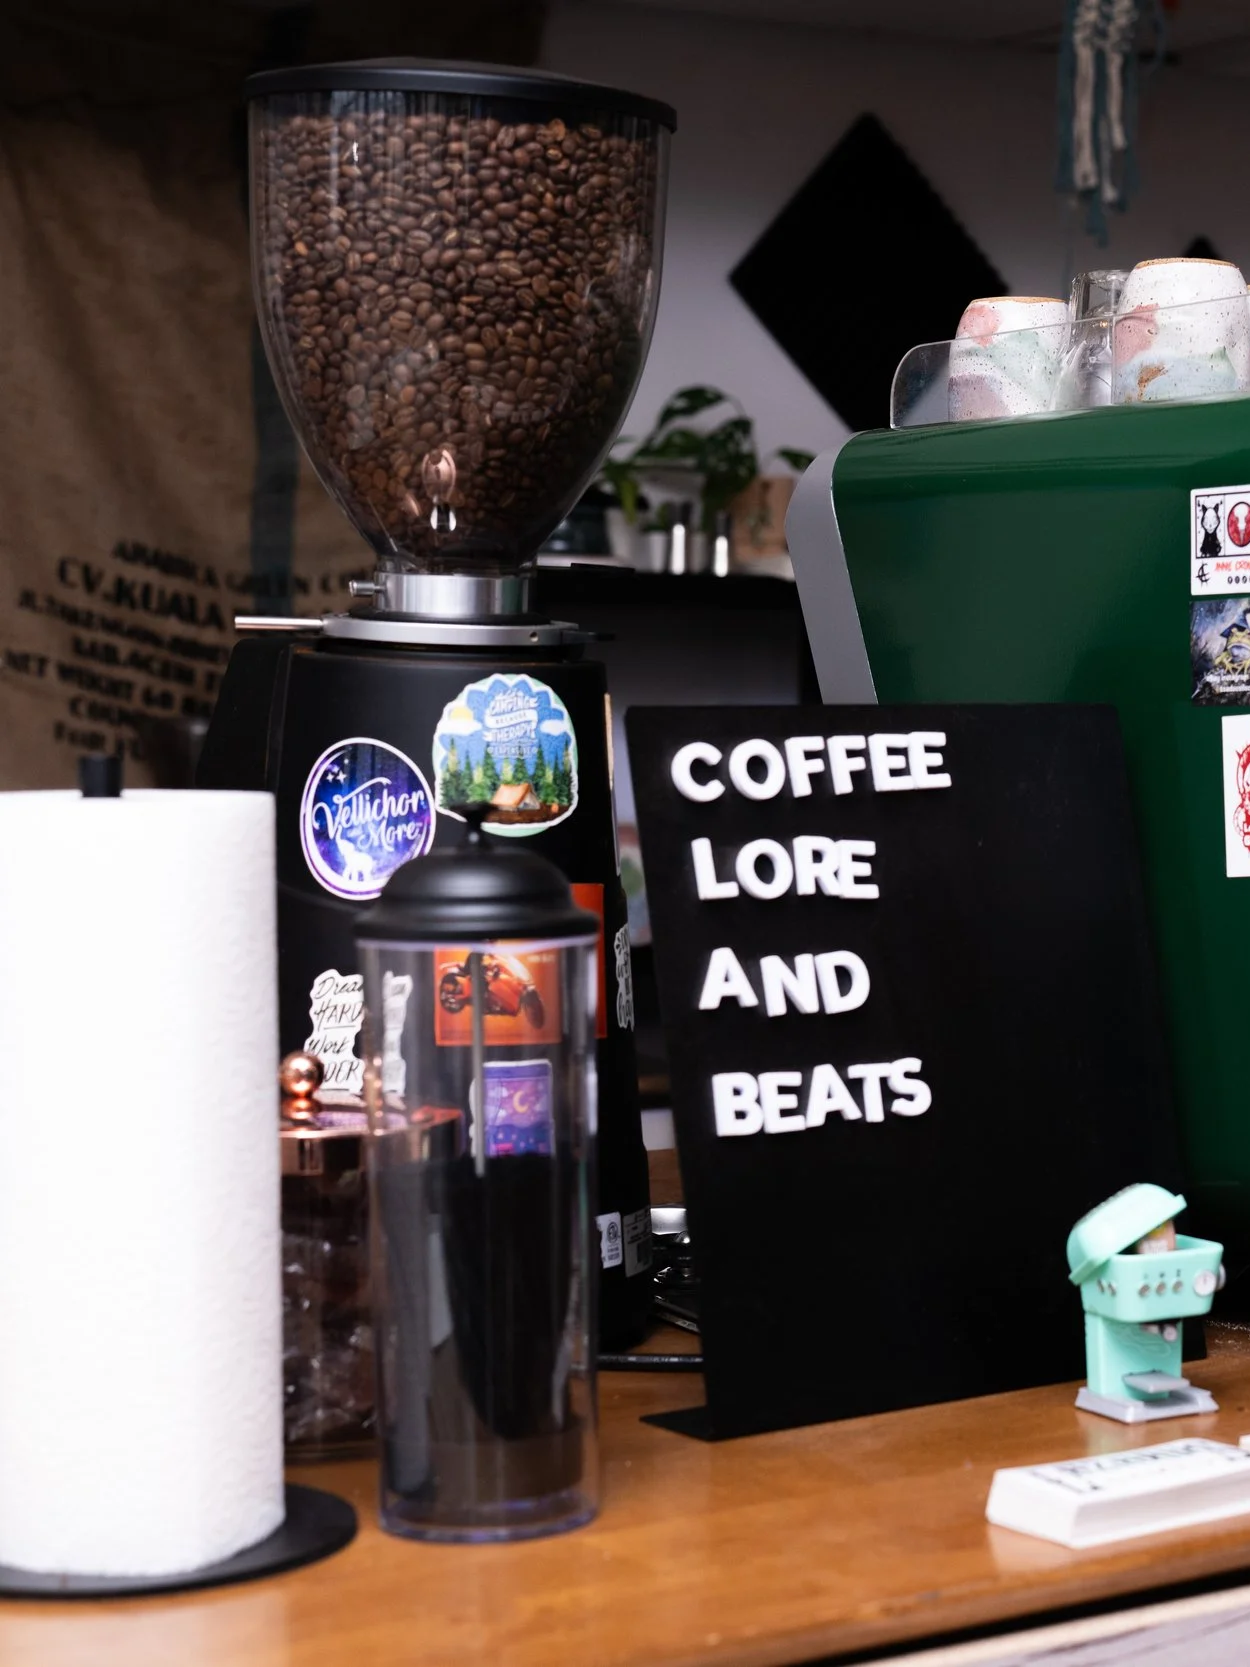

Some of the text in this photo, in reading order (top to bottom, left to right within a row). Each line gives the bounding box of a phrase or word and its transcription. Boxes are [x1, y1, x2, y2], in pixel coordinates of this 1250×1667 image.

[670, 731, 952, 802] COFFEE
[312, 777, 425, 840] Vellichor
[358, 820, 420, 852] More
[690, 834, 879, 900] LORE
[315, 976, 364, 1000] Drea
[698, 946, 870, 1017] AND
[309, 1034, 352, 1057] Work
[323, 1060, 360, 1083] DER
[711, 1056, 932, 1137] BEATS
